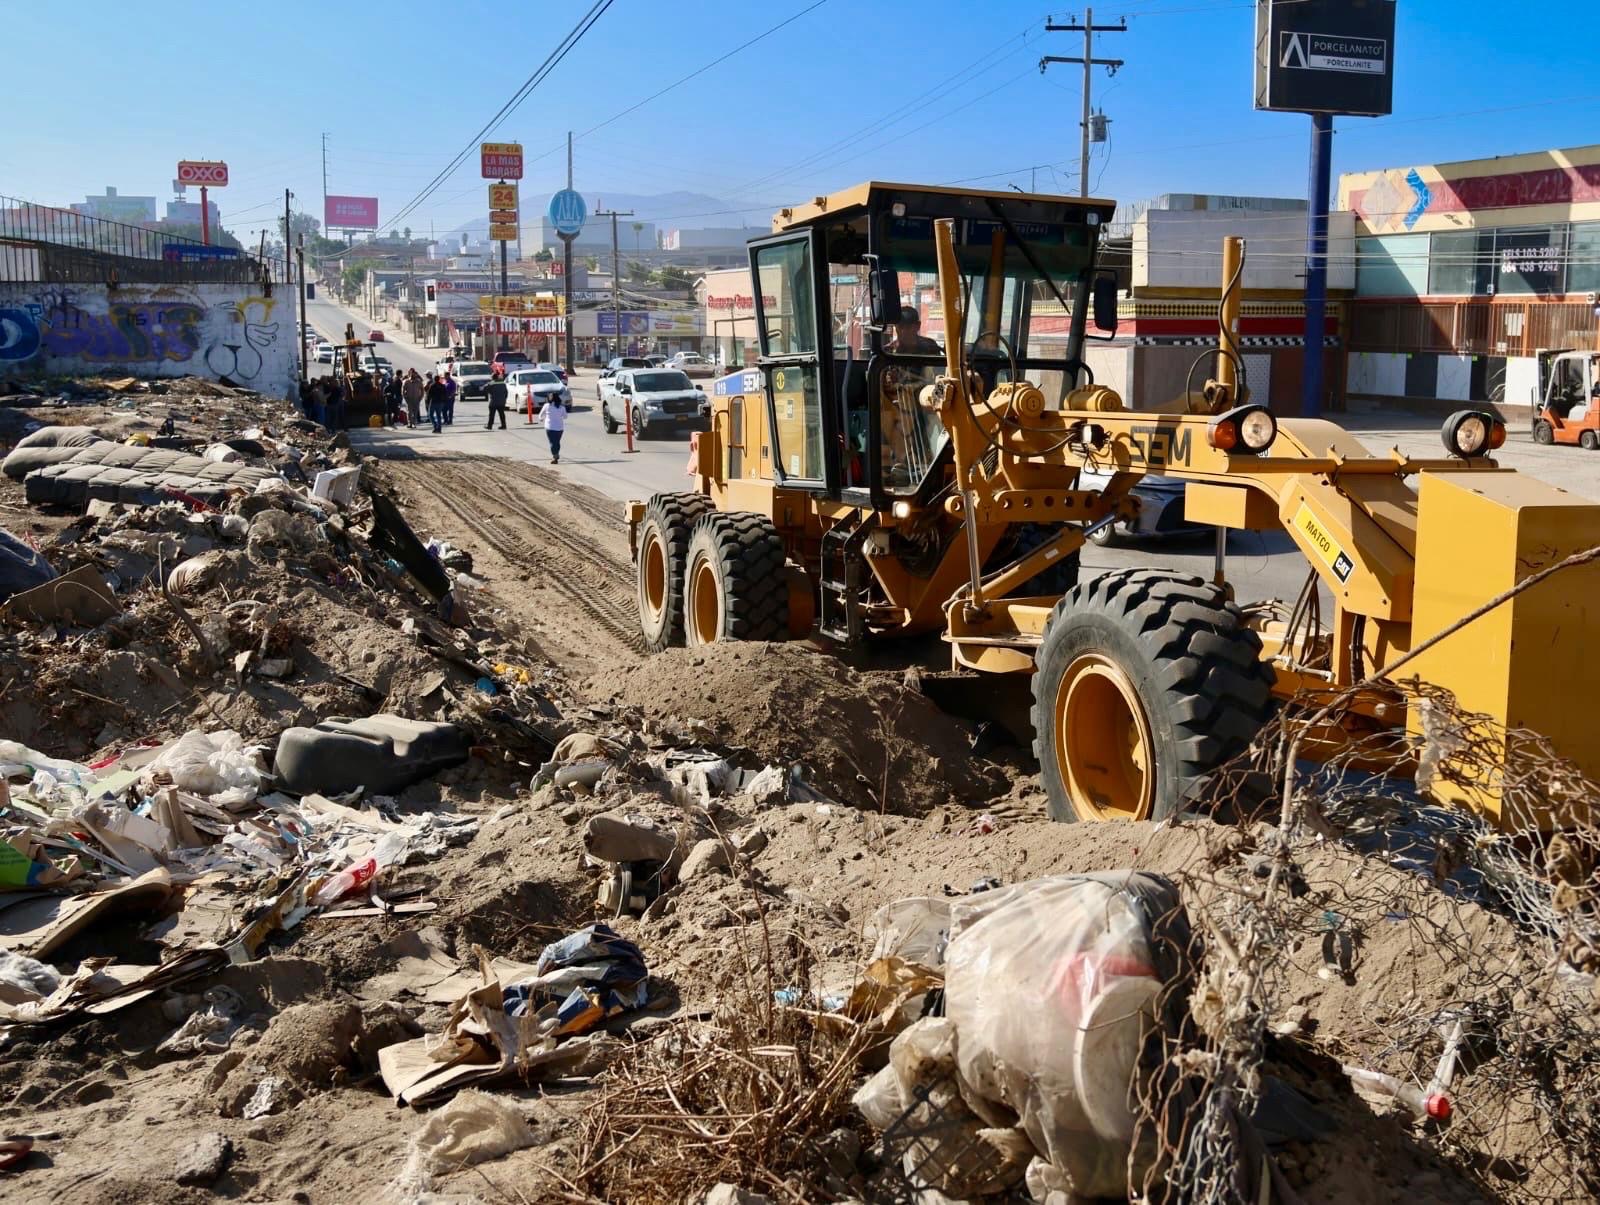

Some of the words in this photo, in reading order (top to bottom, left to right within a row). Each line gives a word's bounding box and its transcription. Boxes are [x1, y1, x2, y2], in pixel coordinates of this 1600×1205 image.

[1314, 41, 1380, 55] PORCELANATO
[1327, 58, 1372, 69] PORCELANITE
[485, 155, 498, 165] LA
[498, 155, 520, 167] MAS
[180, 167, 226, 180] OXXO
[485, 166, 520, 177] BARATA
[494, 190, 514, 202] 24
[1523, 247, 1537, 257] 103
[1540, 247, 1560, 257] 5207
[1501, 261, 1516, 273] 664
[1538, 260, 1559, 272] 9242
[1130, 425, 1192, 468] SEM
[1305, 520, 1331, 553] MATCO
[1335, 556, 1351, 577] CAT
